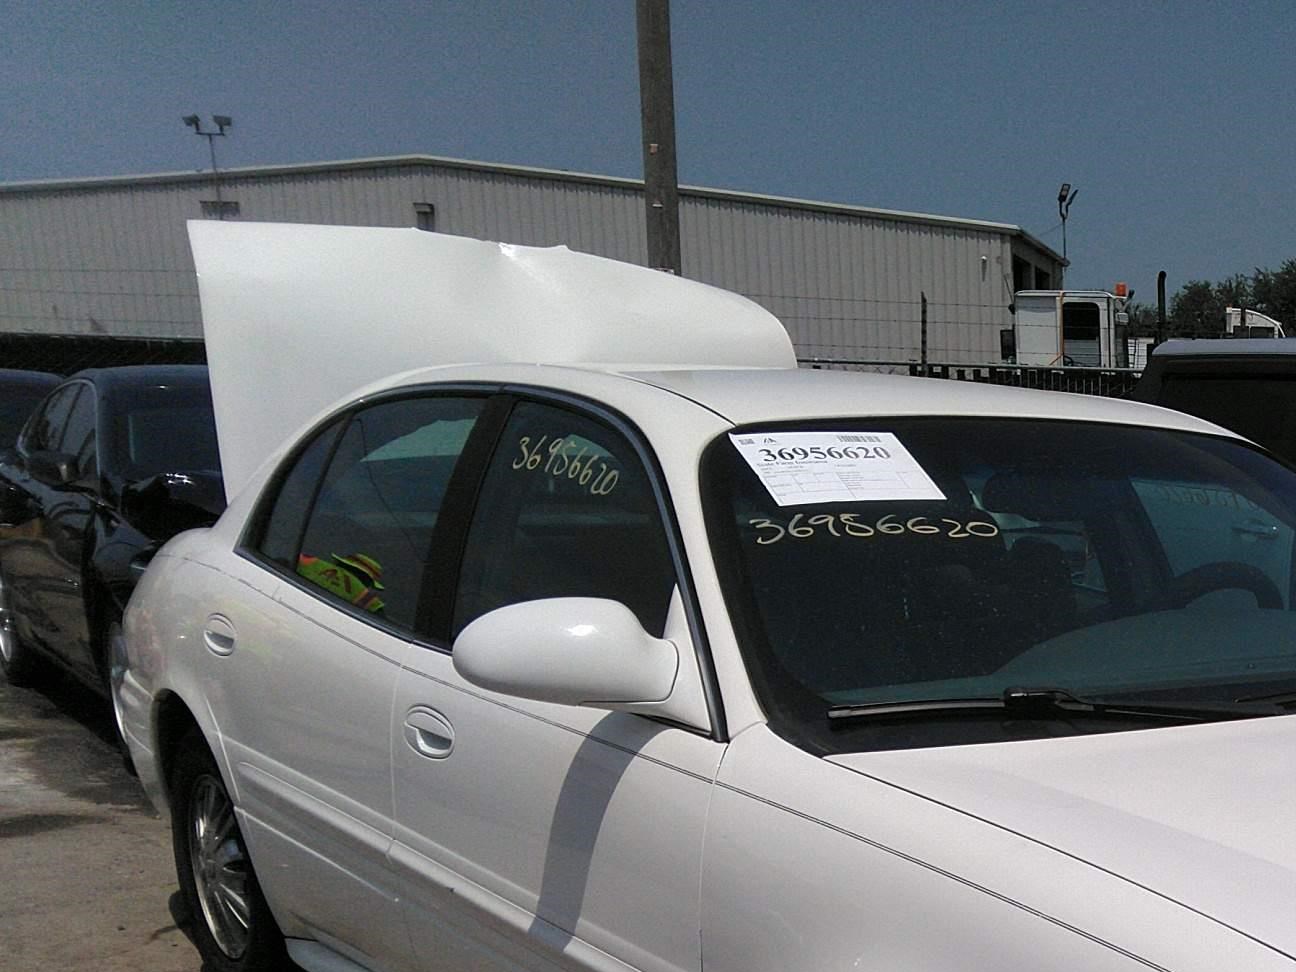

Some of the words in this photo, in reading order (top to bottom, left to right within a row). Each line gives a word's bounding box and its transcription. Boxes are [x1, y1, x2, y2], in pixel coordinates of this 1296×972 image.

[512, 434, 620, 495] 36956620
[758, 445, 892, 462] 36956620
[749, 513, 999, 545] 36956620
